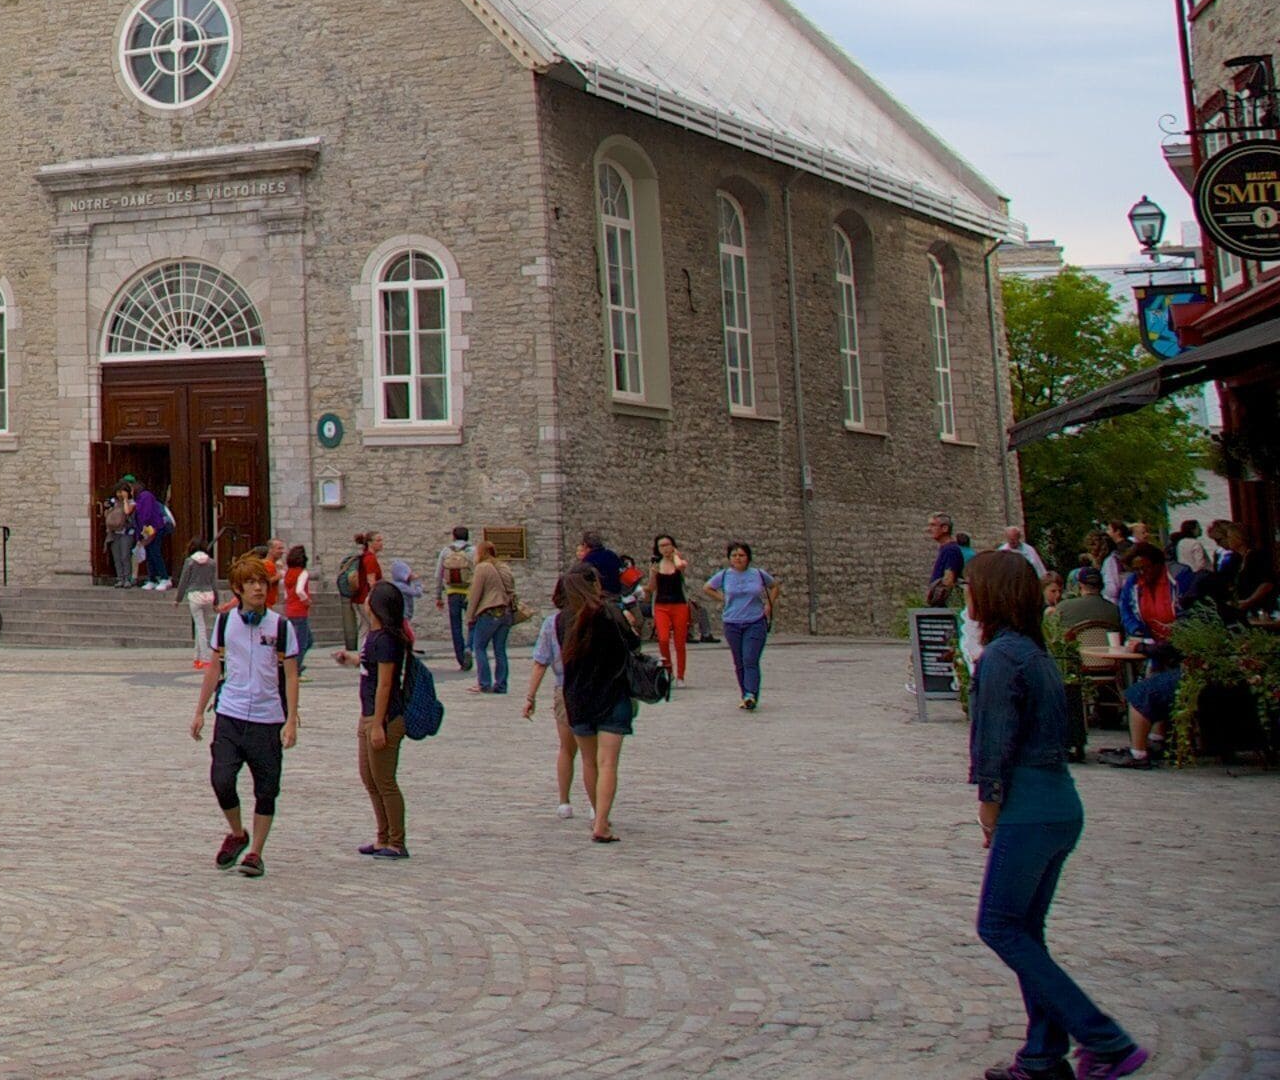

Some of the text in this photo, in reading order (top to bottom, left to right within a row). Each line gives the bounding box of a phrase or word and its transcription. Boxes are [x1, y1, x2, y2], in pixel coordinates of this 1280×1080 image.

[70, 181, 286, 212] NOTRE-DAME DES VICTOIRES
